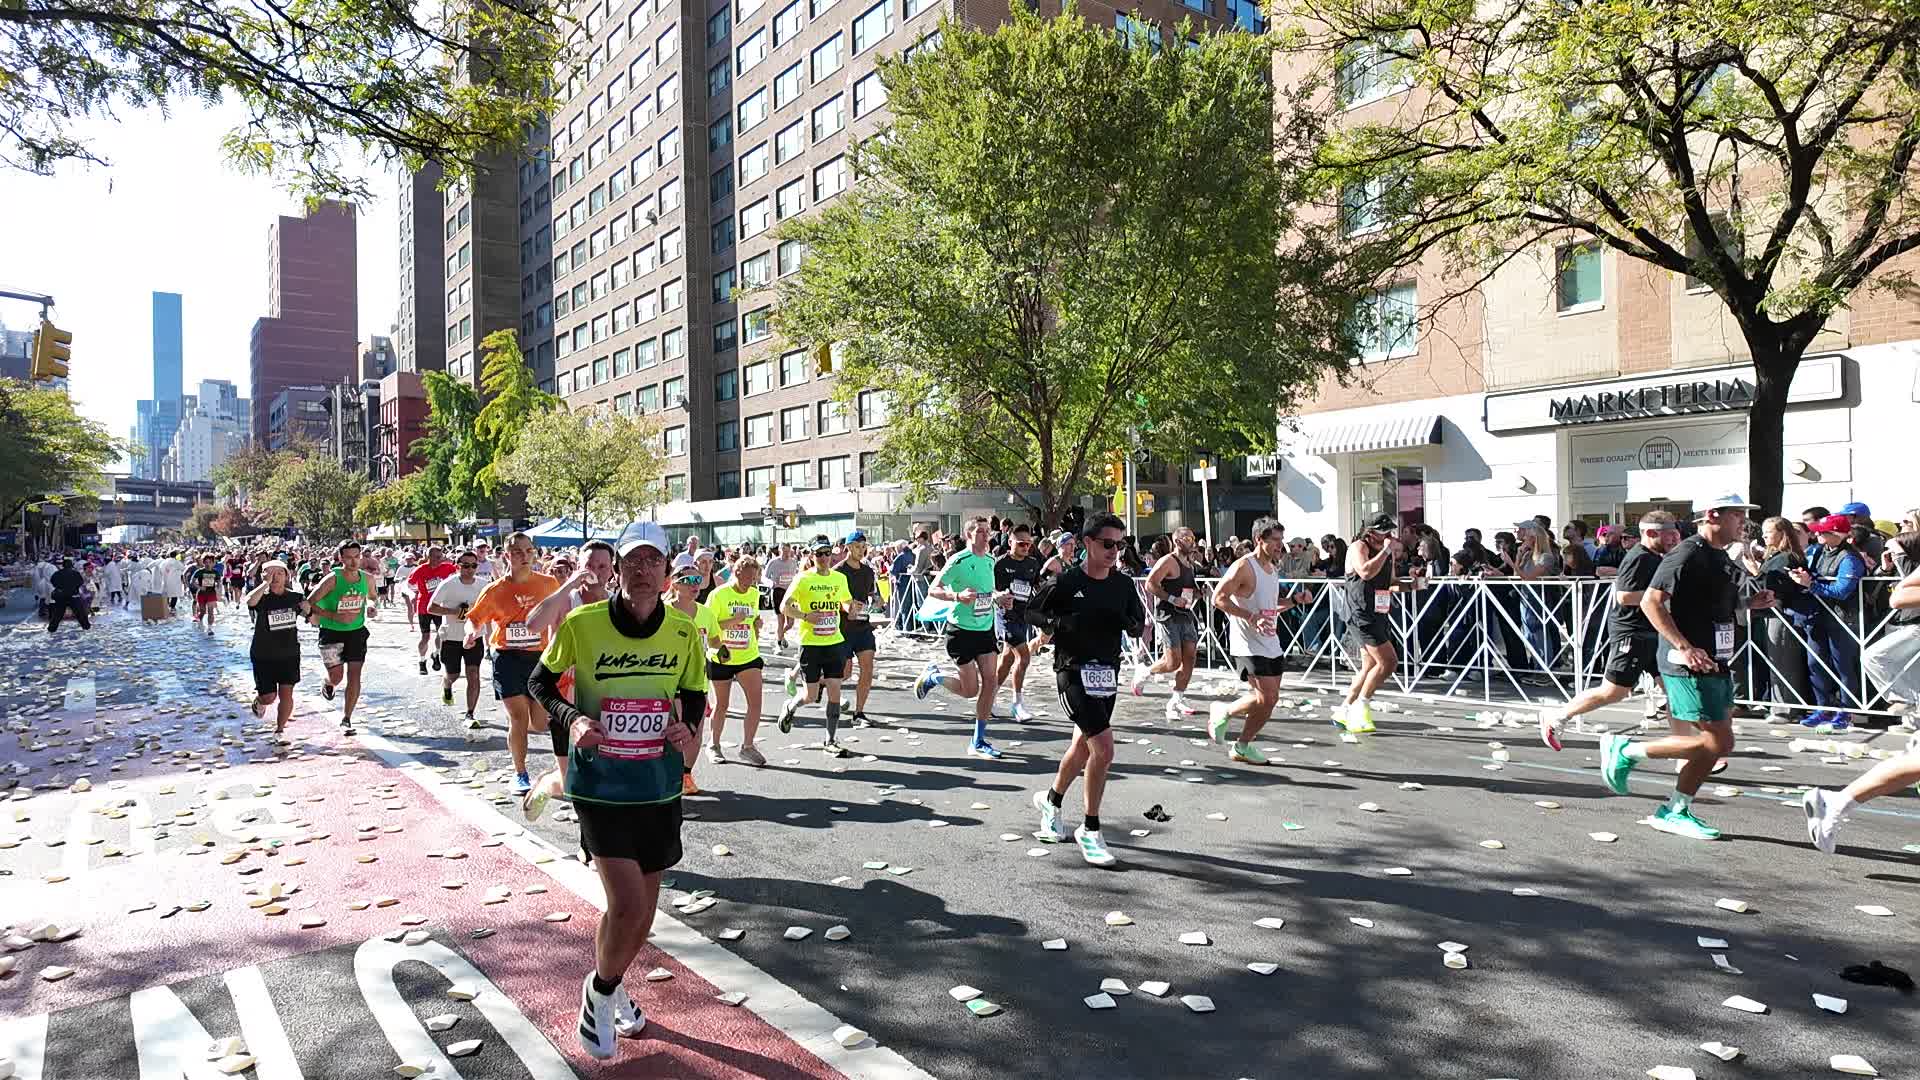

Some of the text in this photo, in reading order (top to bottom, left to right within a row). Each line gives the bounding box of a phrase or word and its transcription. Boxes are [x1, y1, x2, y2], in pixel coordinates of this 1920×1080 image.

[1549, 376, 1754, 418] MARKETERIA
[1605, 454, 1636, 463] QUALITY
[810, 601, 839, 610] GUIDE
[1084, 671, 1112, 683] 16629
[606, 714, 663, 733] 19208
